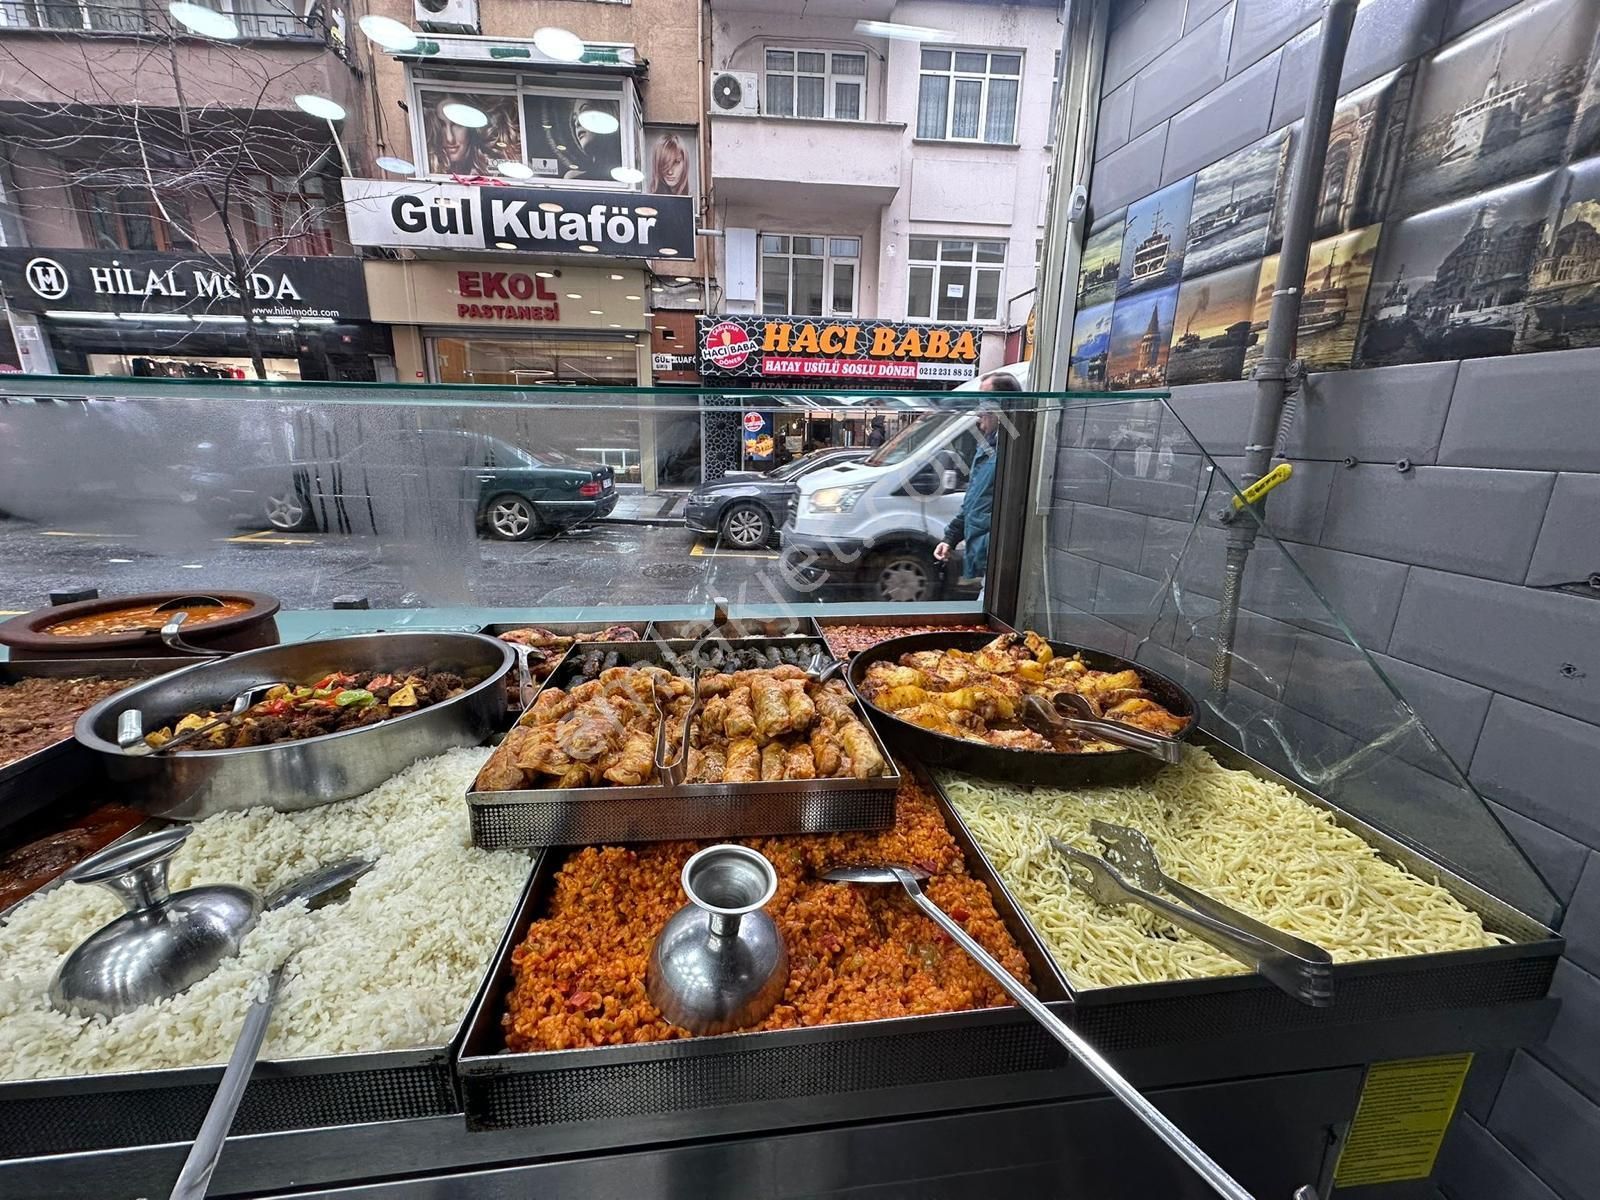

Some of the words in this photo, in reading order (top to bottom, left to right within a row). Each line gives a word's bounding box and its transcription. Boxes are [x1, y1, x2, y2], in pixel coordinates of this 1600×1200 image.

[391, 195, 474, 234] Gül
[491, 200, 657, 245] Kuaför
[89, 260, 187, 297] HİLAL
[193, 270, 301, 300] MODA
[457, 270, 557, 301] EKOL
[252, 305, 340, 317] www.hilalmoda.com
[457, 302, 560, 321] PASTANESİ
[703, 347, 728, 358] HACI
[730, 342, 757, 354] BABA
[762, 323, 860, 355] HACI
[870, 327, 977, 359] BABA
[765, 360, 801, 372] HATAY
[842, 363, 878, 375] SOSLU
[878, 362, 916, 376] DÖNER
[919, 367, 937, 375] 0212
[938, 368, 951, 376] 231
[953, 368, 962, 377] 88
[963, 368, 973, 377] 52
